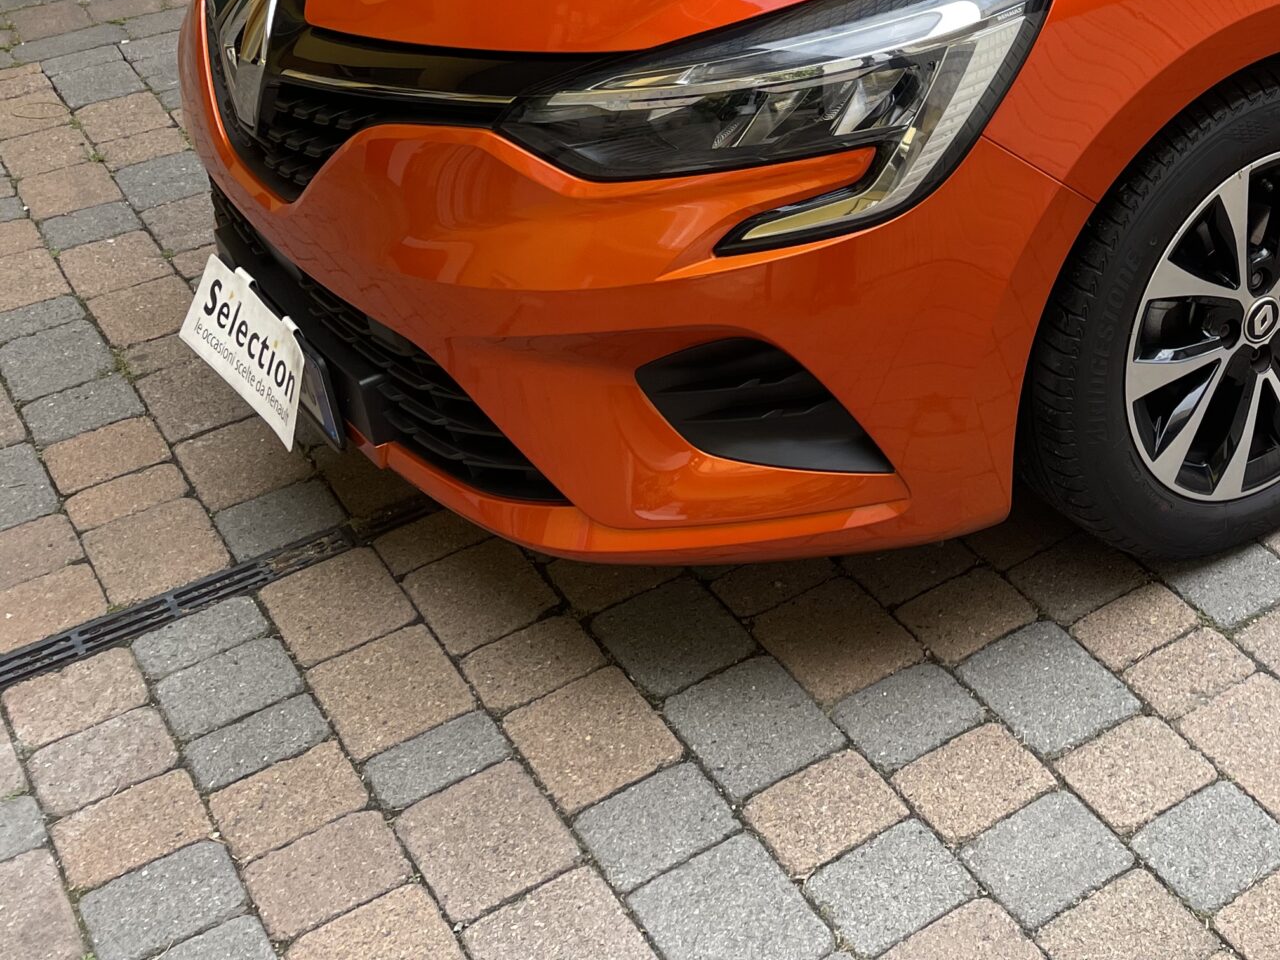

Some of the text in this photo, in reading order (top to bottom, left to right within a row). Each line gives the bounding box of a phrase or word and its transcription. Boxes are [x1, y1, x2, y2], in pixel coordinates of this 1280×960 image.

[194, 317, 291, 428] le occasioni scelte da Renault
